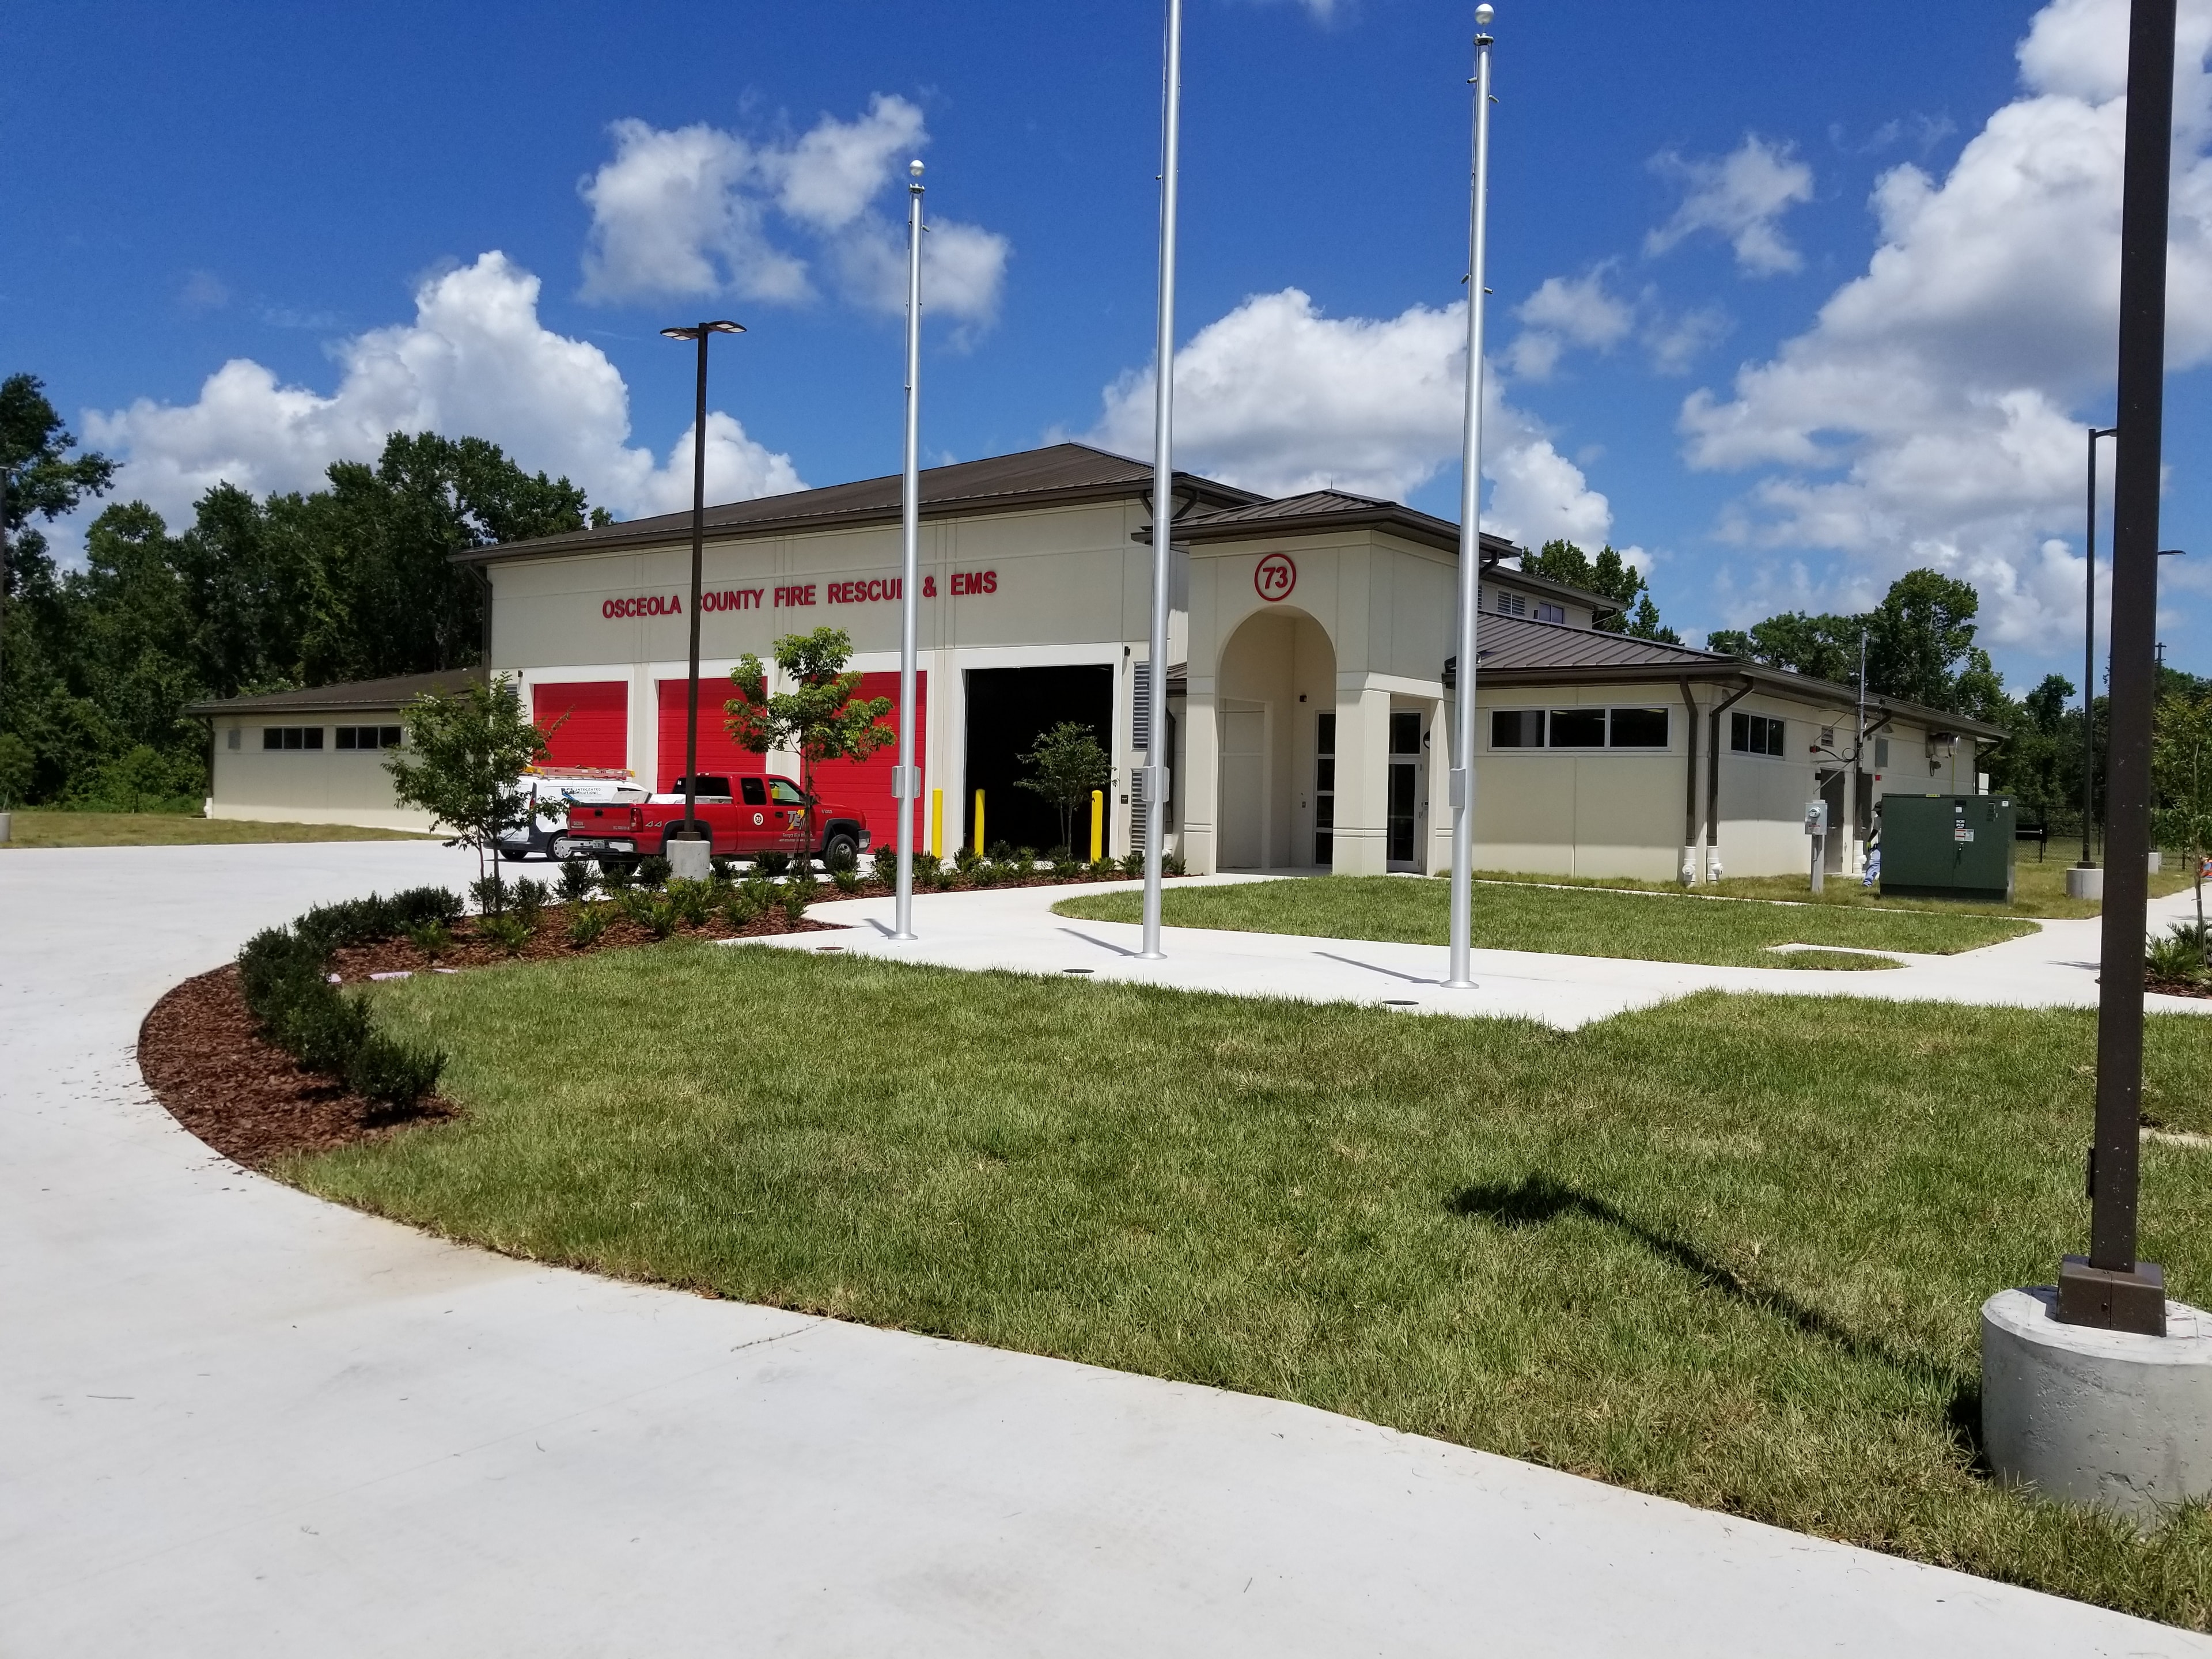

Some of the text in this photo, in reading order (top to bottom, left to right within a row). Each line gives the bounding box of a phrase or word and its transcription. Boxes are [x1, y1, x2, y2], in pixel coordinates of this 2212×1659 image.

[602, 595, 682, 619] OSCEOLA
[700, 589, 764, 612] OUNTY
[774, 585, 816, 608] FIRE
[922, 576, 937, 597] &
[950, 571, 997, 596] EMS
[1262, 566, 1288, 589] 73
